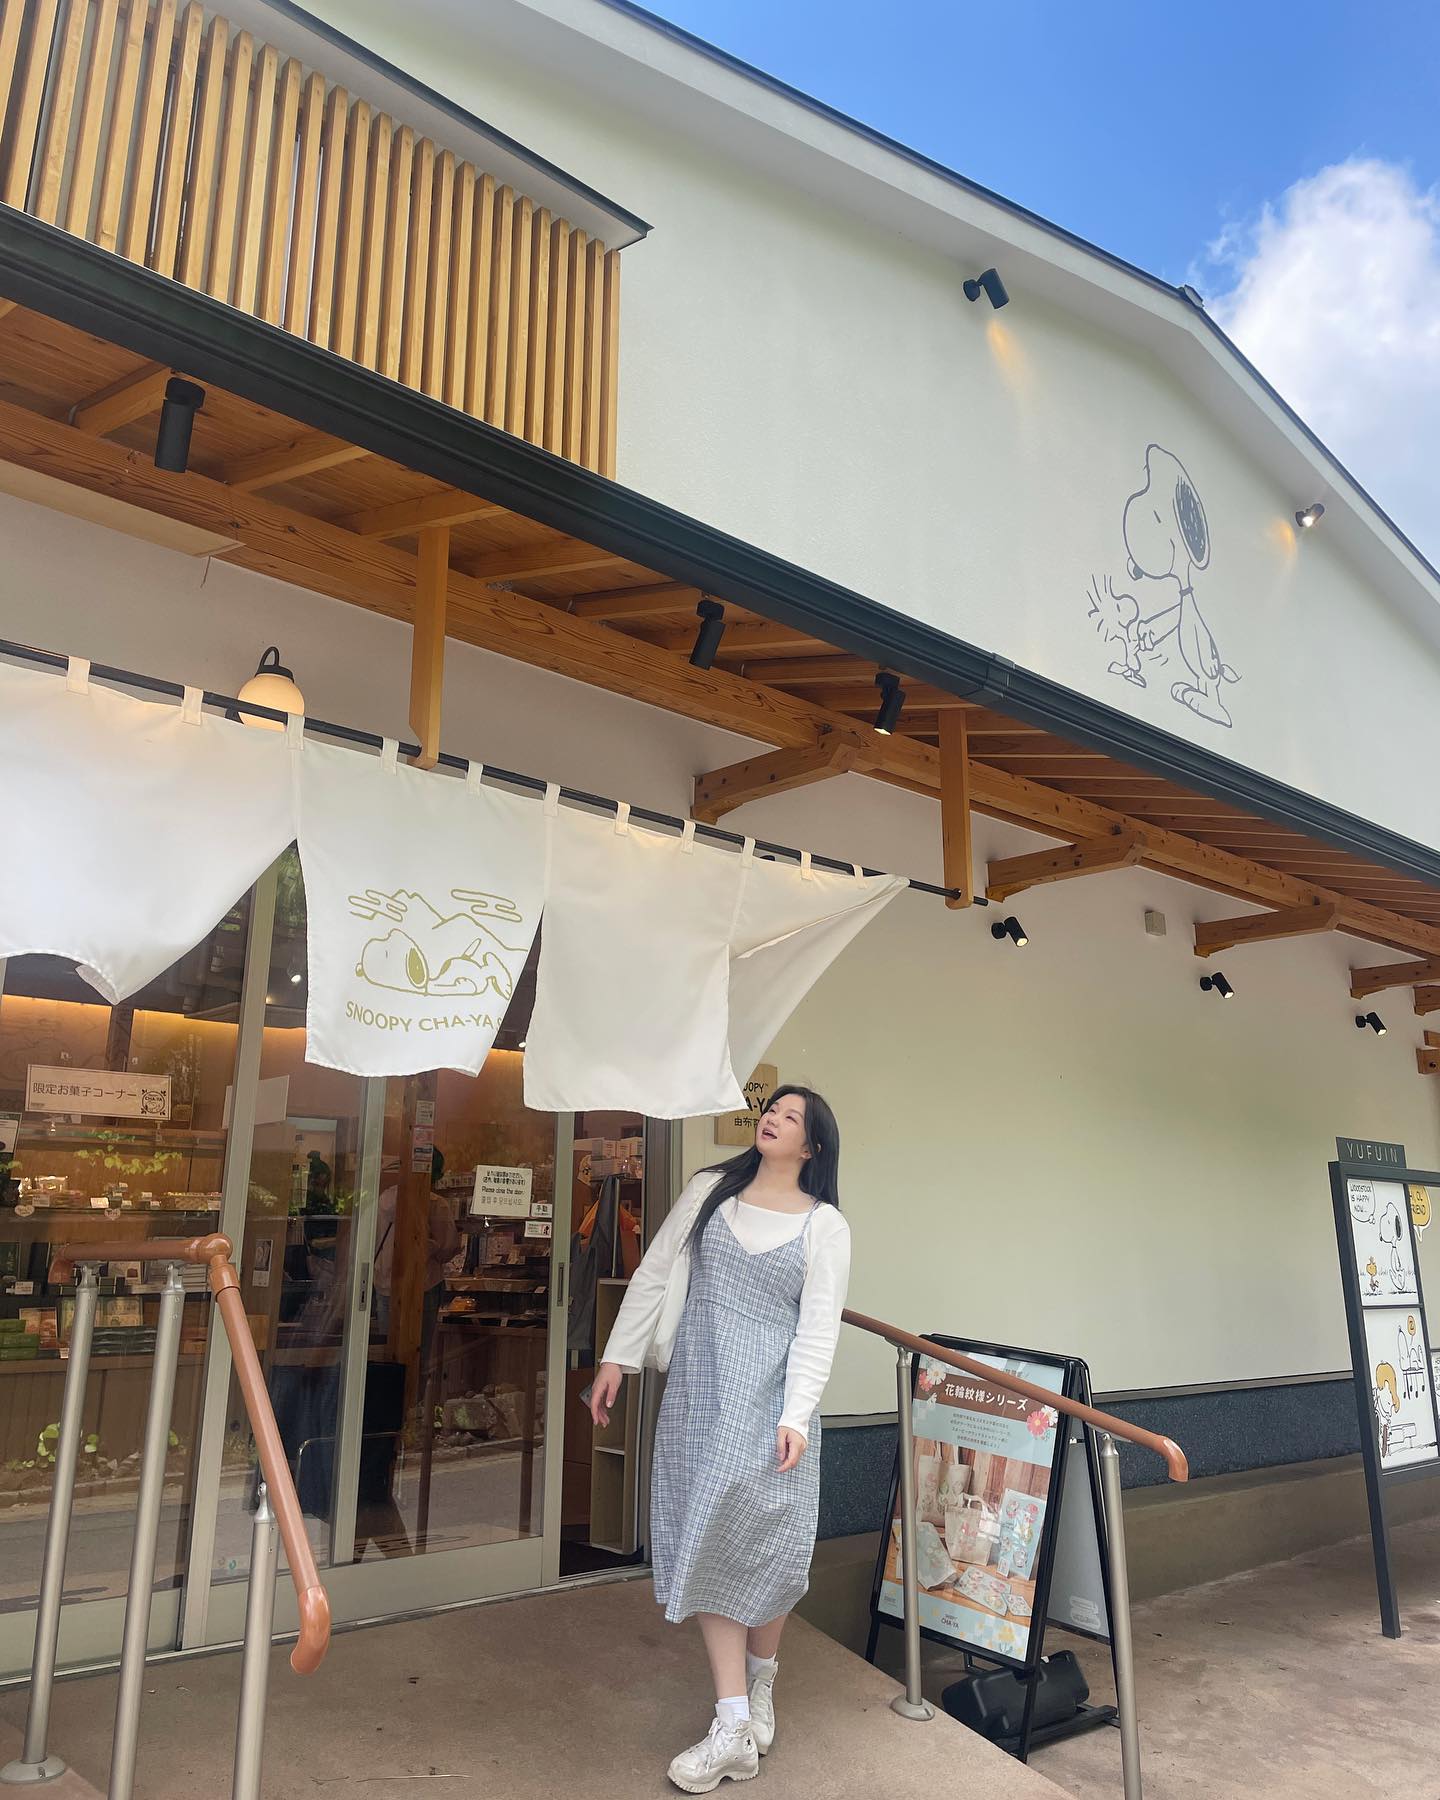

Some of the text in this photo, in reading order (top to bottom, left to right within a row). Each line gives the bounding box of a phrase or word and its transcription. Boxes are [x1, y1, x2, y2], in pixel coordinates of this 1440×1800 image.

[345, 1000, 413, 1032] SNOOPY
[418, 1014, 494, 1031] CHA-YA
[32, 1082, 137, 1100] 限定お菓子コーナー
[1346, 1142, 1398, 1163] YUFUIN
[945, 1383, 1029, 1411] 花輪紋様シリーズ
